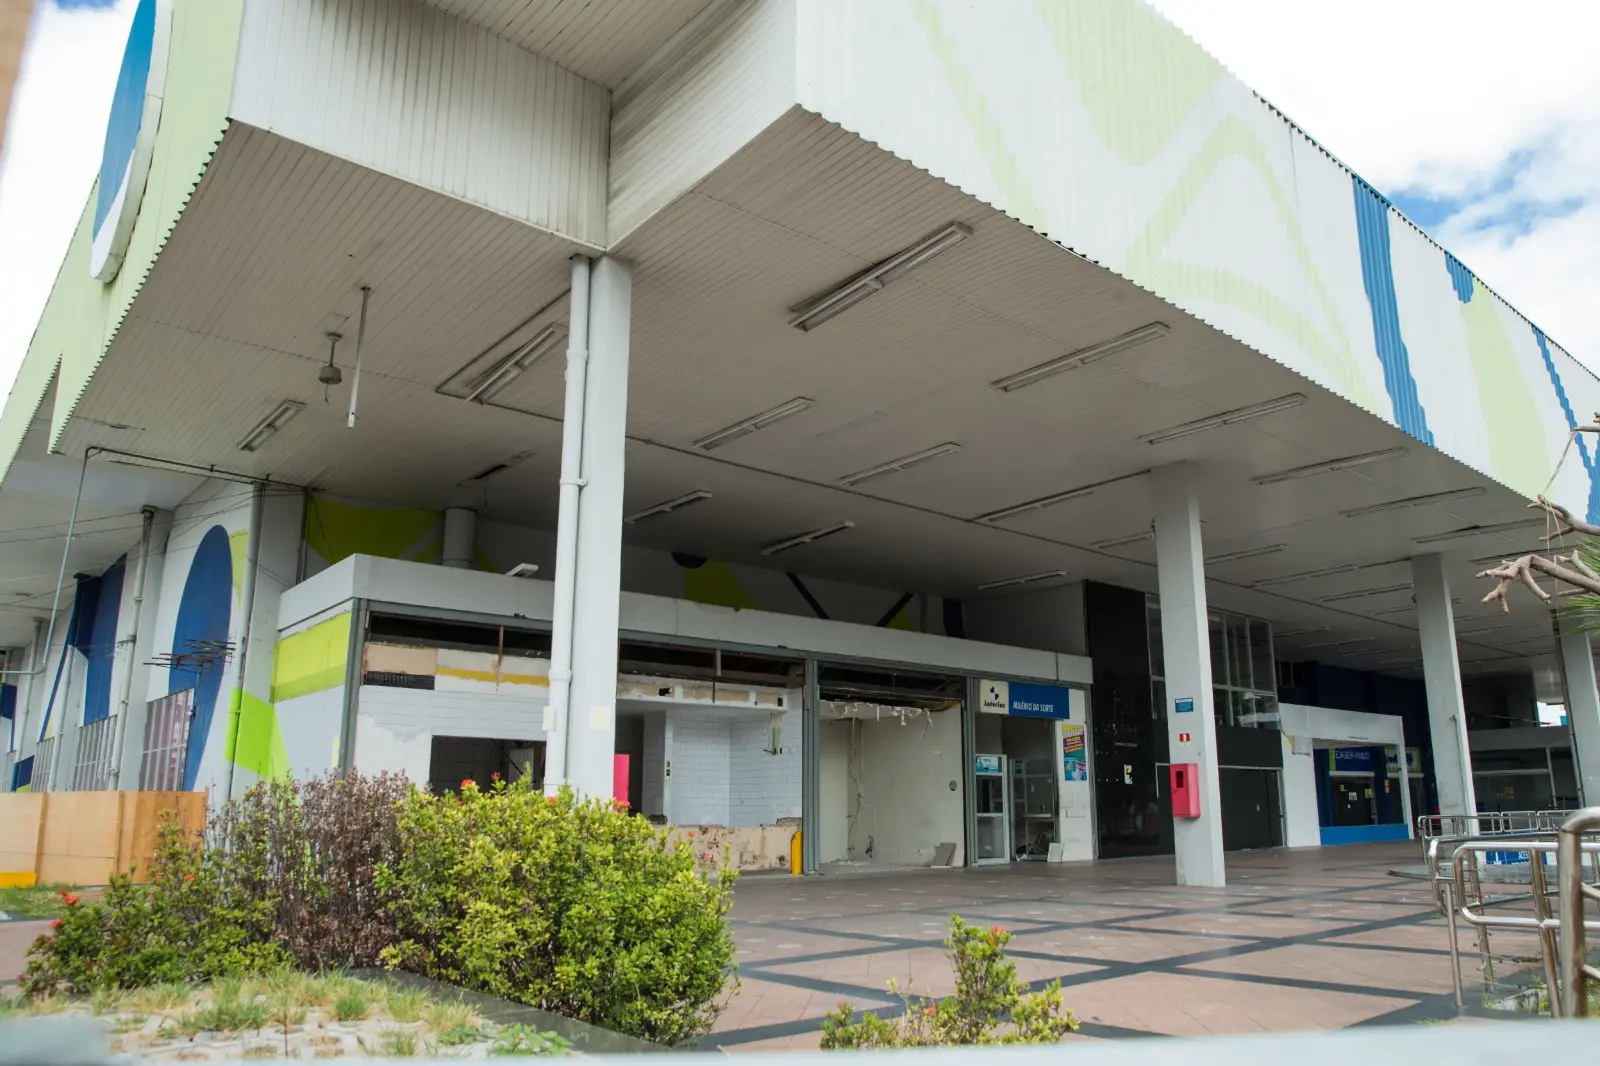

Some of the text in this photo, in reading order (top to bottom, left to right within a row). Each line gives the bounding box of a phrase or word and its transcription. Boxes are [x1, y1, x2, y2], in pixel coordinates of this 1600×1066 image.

[984, 700, 1006, 709] Loterias
[1033, 702, 1040, 712] DA
[1040, 703, 1054, 713] SORTE
[1518, 851, 1529, 859] ACES
